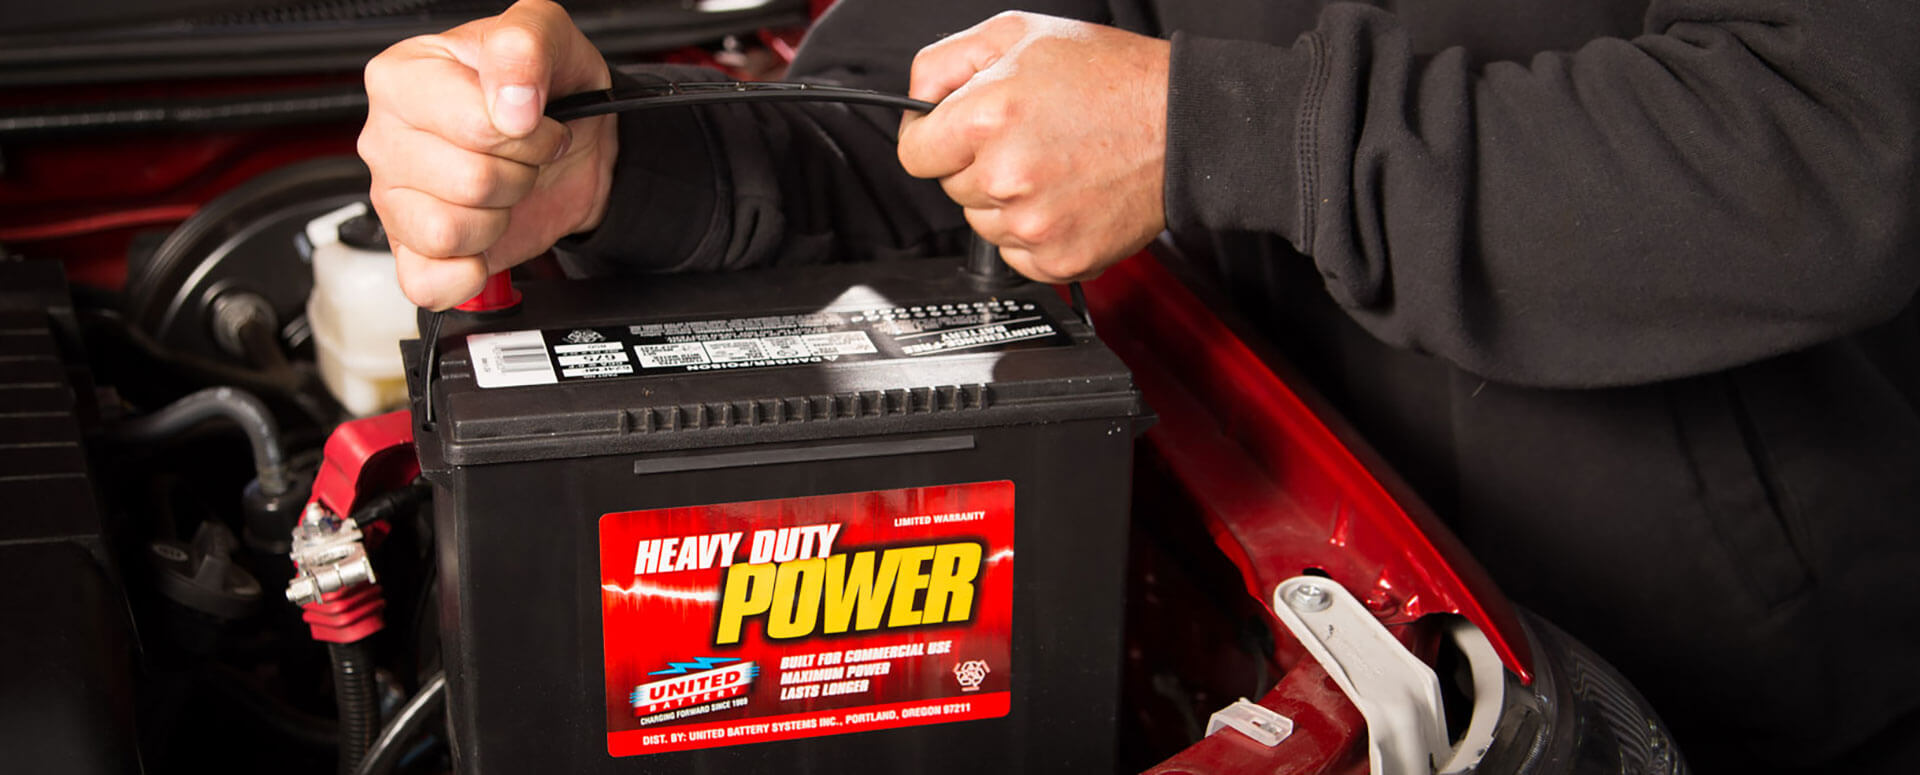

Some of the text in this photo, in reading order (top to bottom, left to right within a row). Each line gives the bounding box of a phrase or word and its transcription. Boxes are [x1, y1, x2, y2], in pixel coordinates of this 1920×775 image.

[894, 511, 985, 527] LIMITED WARRANTY
[634, 523, 841, 575] HEAVY DUTY
[716, 542, 983, 645] POWER
[780, 640, 952, 670] BUILT FOR COMMERCIAL USE
[649, 670, 741, 701] UNITED
[780, 662, 891, 685] MAXIMUM POWER
[649, 687, 738, 713] BATTERY
[780, 679, 870, 701] LASTS LONGER
[640, 711, 676, 726] CHARGING
[676, 704, 710, 719] FORWARD
[711, 699, 731, 712] SINCE
[642, 734, 668, 746] DIST.
[670, 732, 687, 743] BY:
[689, 729, 725, 741] UNITED
[727, 723, 770, 737] BATTERY
[771, 718, 818, 733] SYSTEMS
[845, 710, 900, 725] PORTLAND,
[901, 704, 942, 719] OREGON
[943, 702, 971, 715] 97211
